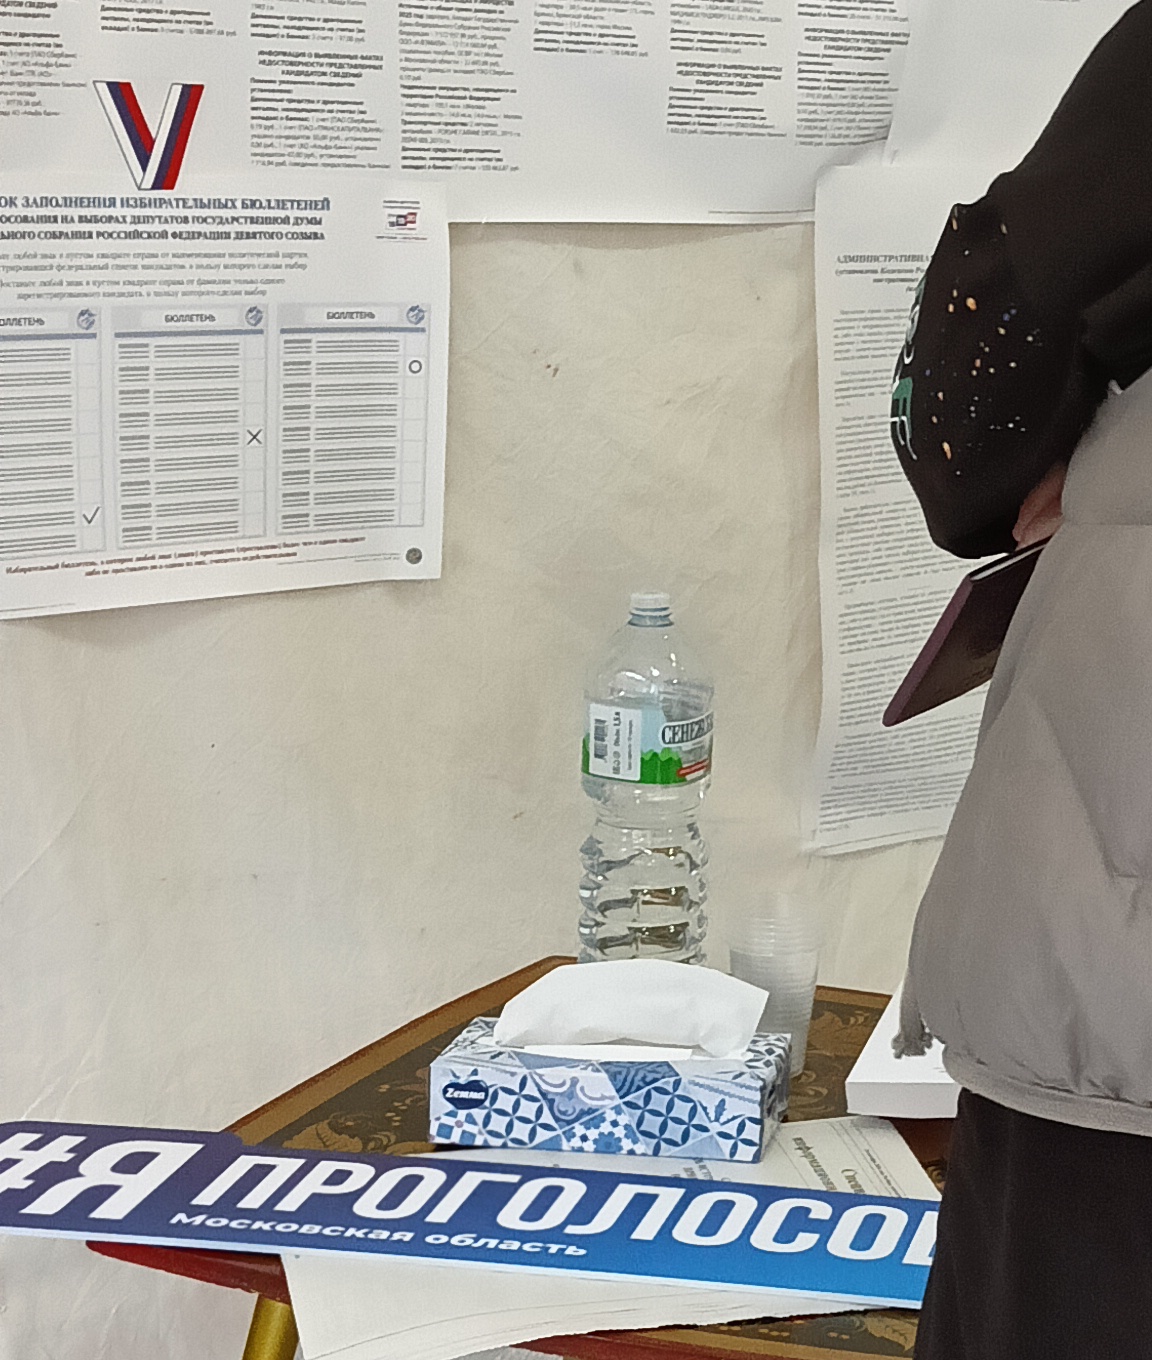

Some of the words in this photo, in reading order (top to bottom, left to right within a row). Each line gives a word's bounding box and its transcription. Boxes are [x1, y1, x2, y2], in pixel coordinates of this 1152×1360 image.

[21, 196, 116, 209] ЗАПОЛНЕНИЯ
[120, 197, 238, 210] ИЗБИРАТЕЛЬНЫХ
[241, 197, 330, 211] БЮЛЛЕТЕНЕЙ
[60, 215, 75, 224] НА
[78, 215, 127, 225] ВЫБОРАХ
[129, 215, 189, 225] ДЕПУТАТОВ
[191, 214, 290, 226] ГОСУДАРСТВЕННОЙ
[165, 313, 216, 323] БЮЛЛЕТЕНЬ
[170, 1212, 414, 1242] Московская
[425, 1231, 588, 1257] область
